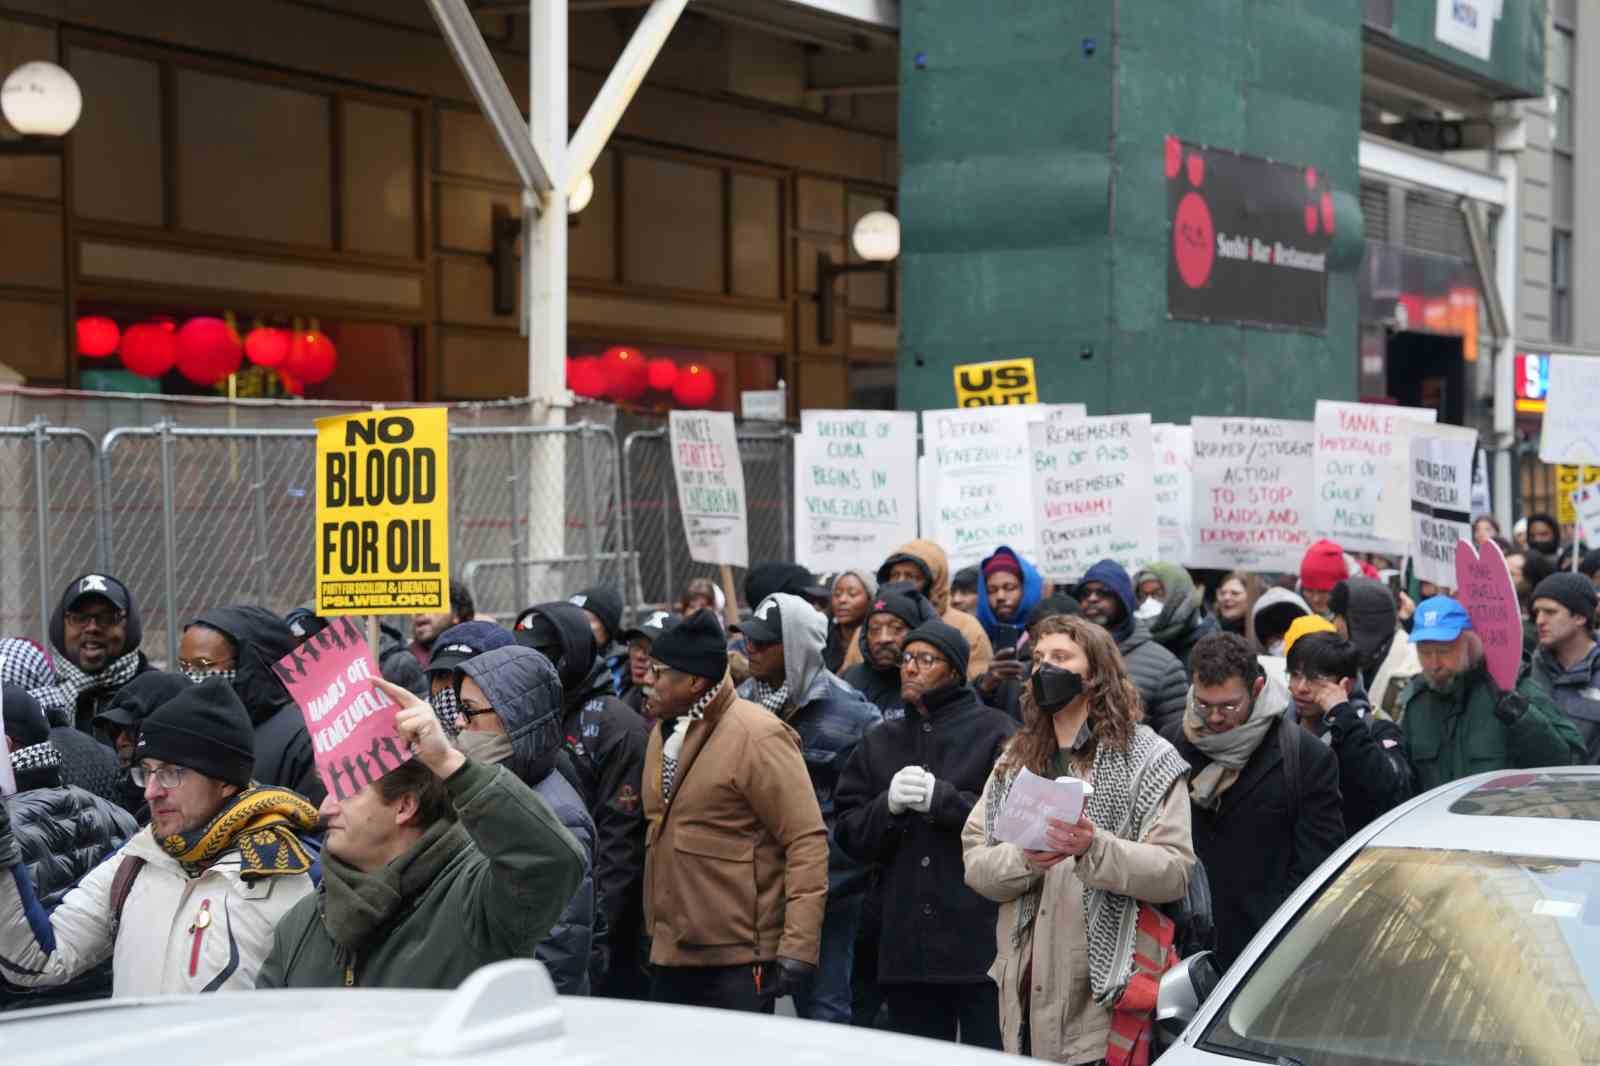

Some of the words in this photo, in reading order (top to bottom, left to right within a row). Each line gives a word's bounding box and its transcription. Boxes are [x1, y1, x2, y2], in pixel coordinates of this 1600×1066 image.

[1216, 232, 1248, 260] Sushi
[1252, 237, 1270, 263] Bar
[960, 366, 1030, 392] US
[345, 416, 414, 447] NO
[1046, 421, 1132, 446] REMEMBER
[326, 447, 436, 508] BLOOD
[1045, 472, 1127, 496] REMEMBER
[1223, 466, 1281, 483] ACTION
[805, 495, 898, 519] VENEZUELA!
[1211, 487, 1235, 505] TO
[1248, 486, 1293, 504] STOP
[1043, 498, 1113, 519] VIETNAM!
[1212, 506, 1262, 525] RAIDS
[1266, 507, 1298, 526] AND
[322, 520, 379, 575] FOR
[386, 518, 440, 574] OIL
[388, 581, 397, 594] &
[322, 594, 439, 608] PSLWEB.ORG
[313, 686, 395, 753] VENEZUELA
